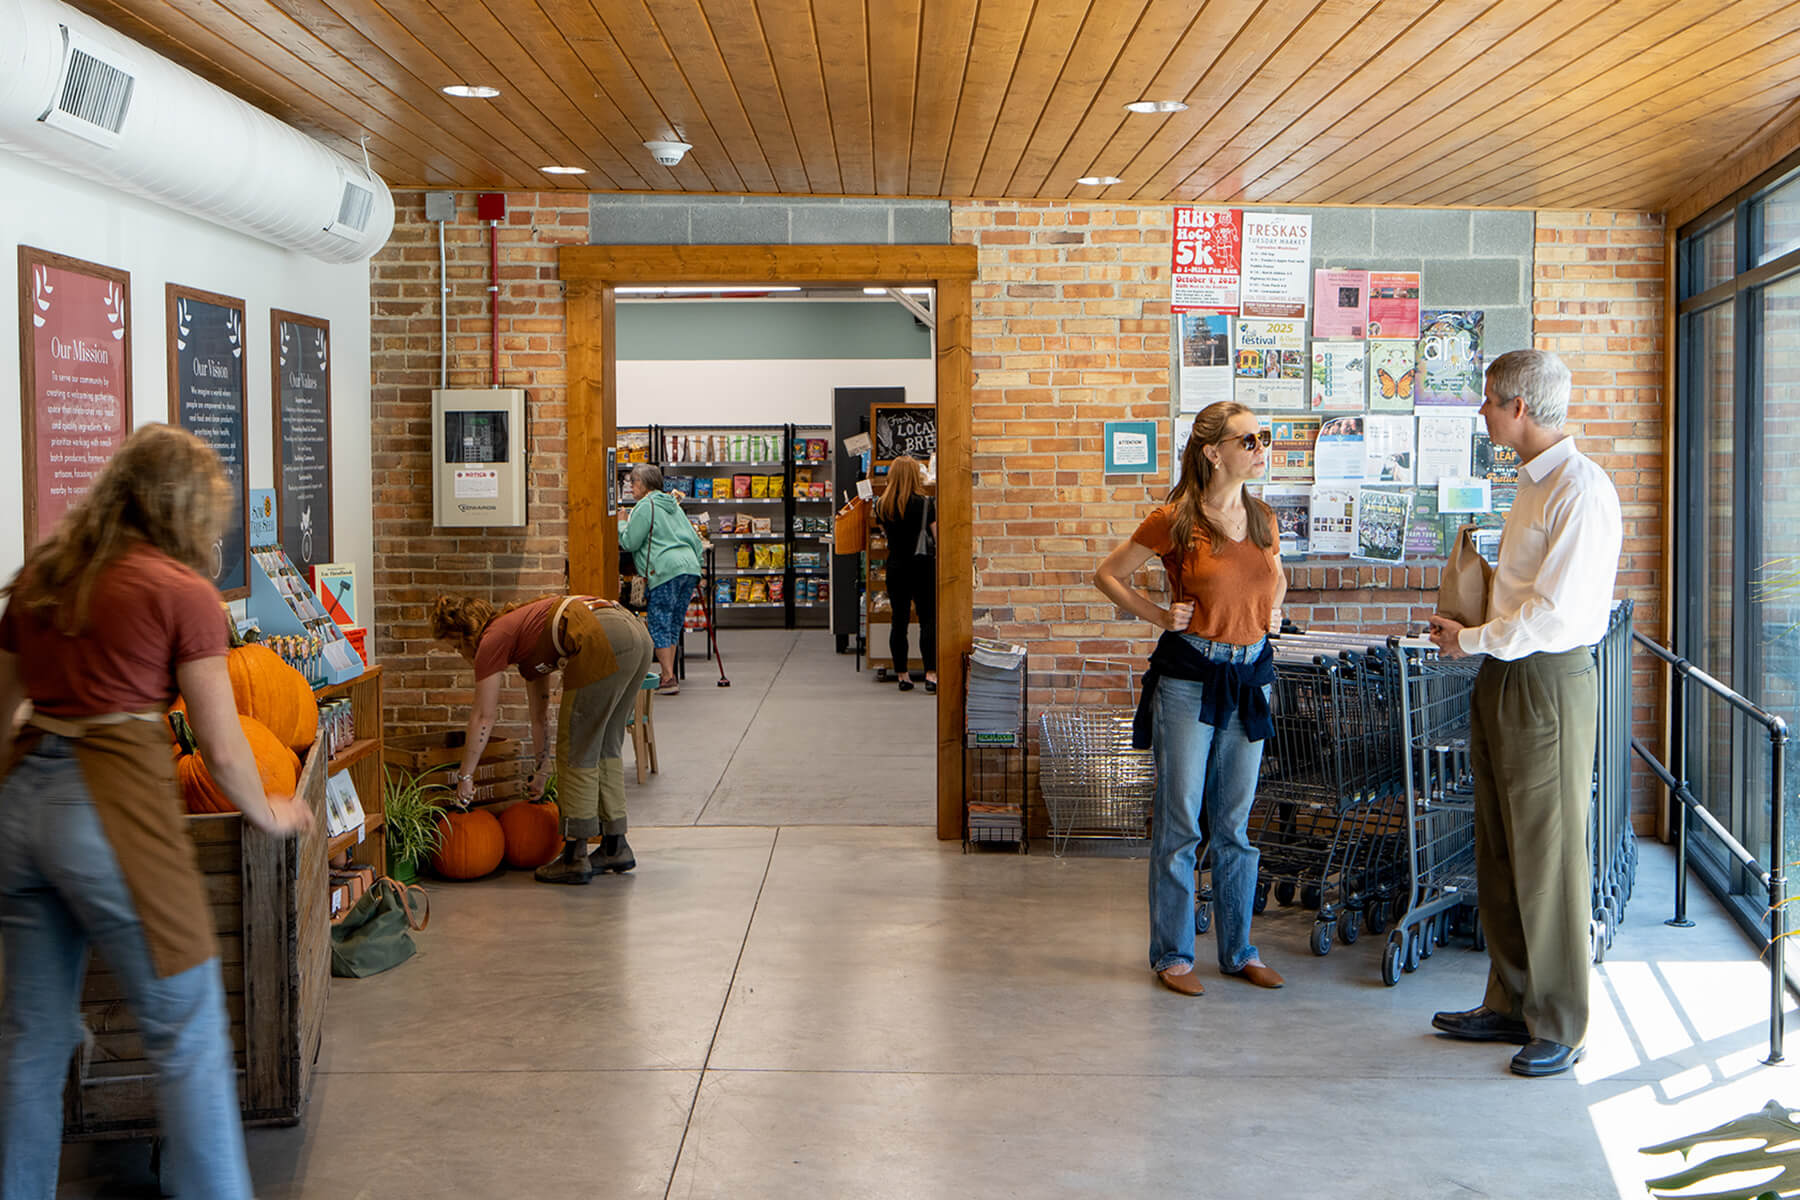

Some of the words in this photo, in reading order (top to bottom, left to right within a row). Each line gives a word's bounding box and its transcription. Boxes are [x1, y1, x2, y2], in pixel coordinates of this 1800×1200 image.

[1177, 209, 1216, 228] HHS
[1176, 228, 1211, 240] HoCo
[1248, 224, 1308, 238] TRESKA'S
[1248, 237, 1278, 245] TUESDAY
[1176, 240, 1215, 265] 5k
[1218, 277, 1238, 285] 2025
[1266, 323, 1294, 333] 2025
[1241, 335, 1276, 345] festival
[51, 336, 72, 360] Our
[73, 339, 109, 365] Mission
[1424, 335, 1475, 361] art
[193, 357, 207, 376] Our
[207, 359, 229, 379] Vision
[51, 370, 58, 381] To
[79, 375, 103, 386] community
[103, 375, 109, 388] by
[289, 371, 301, 388] Our
[300, 372, 317, 390] Values
[191, 385, 197, 394] We
[888, 412, 915, 427] Fresh
[51, 420, 61, 430] and
[62, 421, 77, 432] quality
[103, 422, 111, 431] We
[90, 436, 98, 447] with
[50, 451, 63, 463] batch
[1494, 451, 1517, 462] LEAF
